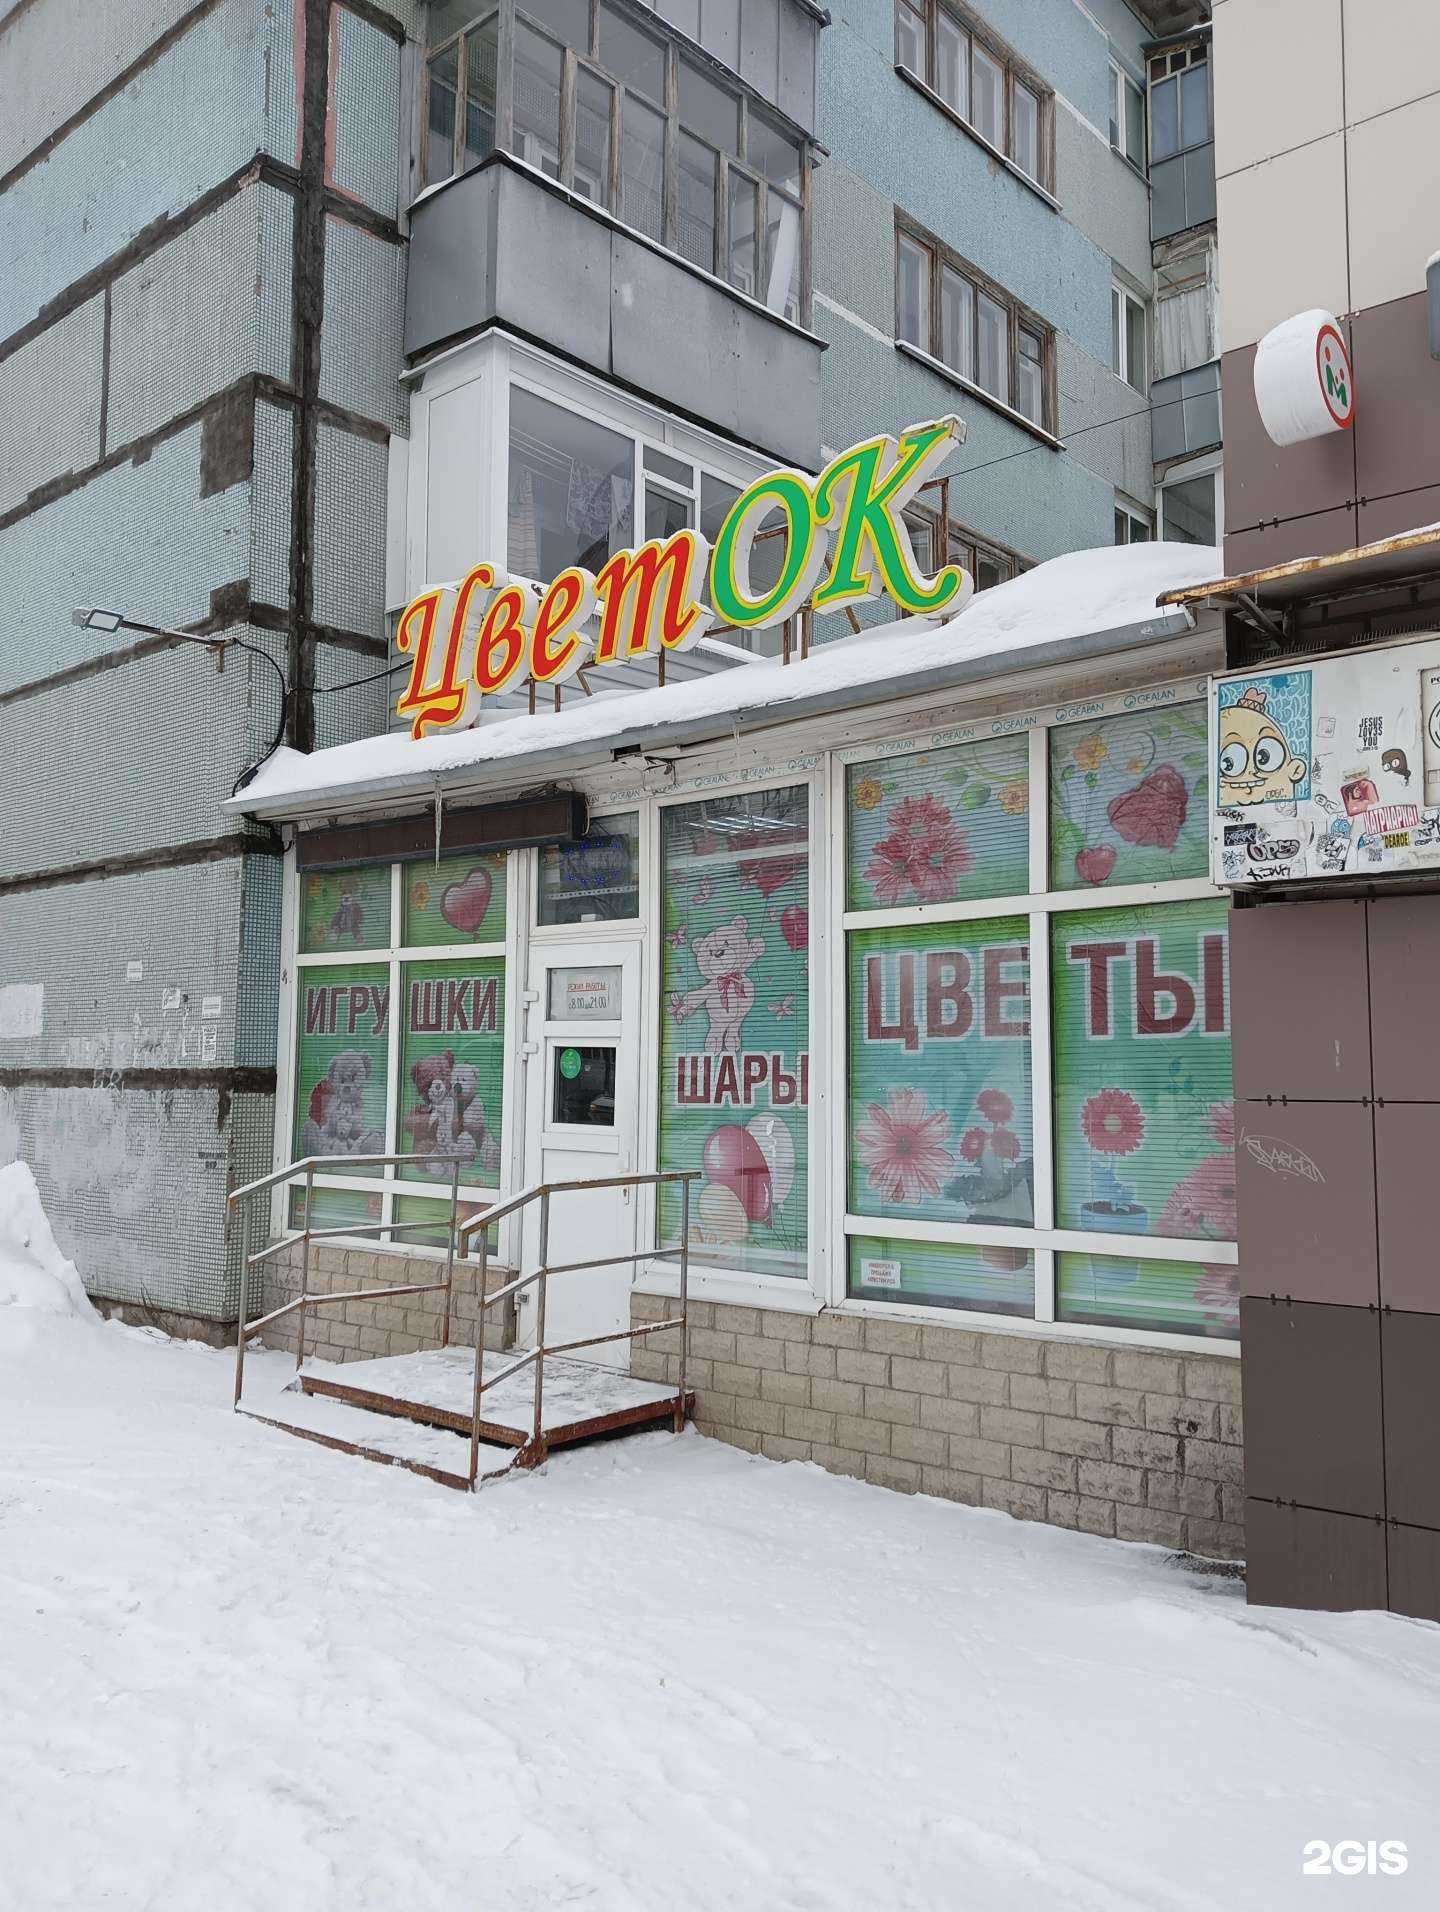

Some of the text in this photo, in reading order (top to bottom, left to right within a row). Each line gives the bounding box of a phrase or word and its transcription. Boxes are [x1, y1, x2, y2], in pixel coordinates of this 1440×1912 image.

[397, 421, 966, 739] ЦветОК
[1138, 690, 1176, 704] GEALAN
[1068, 703, 1104, 717] GEALAN
[1003, 716, 1037, 731] GEALAN
[1359, 716, 1383, 728] JESUS
[942, 728, 975, 742] GEALAN
[1363, 736, 1378, 747] YOU
[885, 740, 915, 752] GEALAN
[677, 1054, 808, 1105] ШАРЫ
